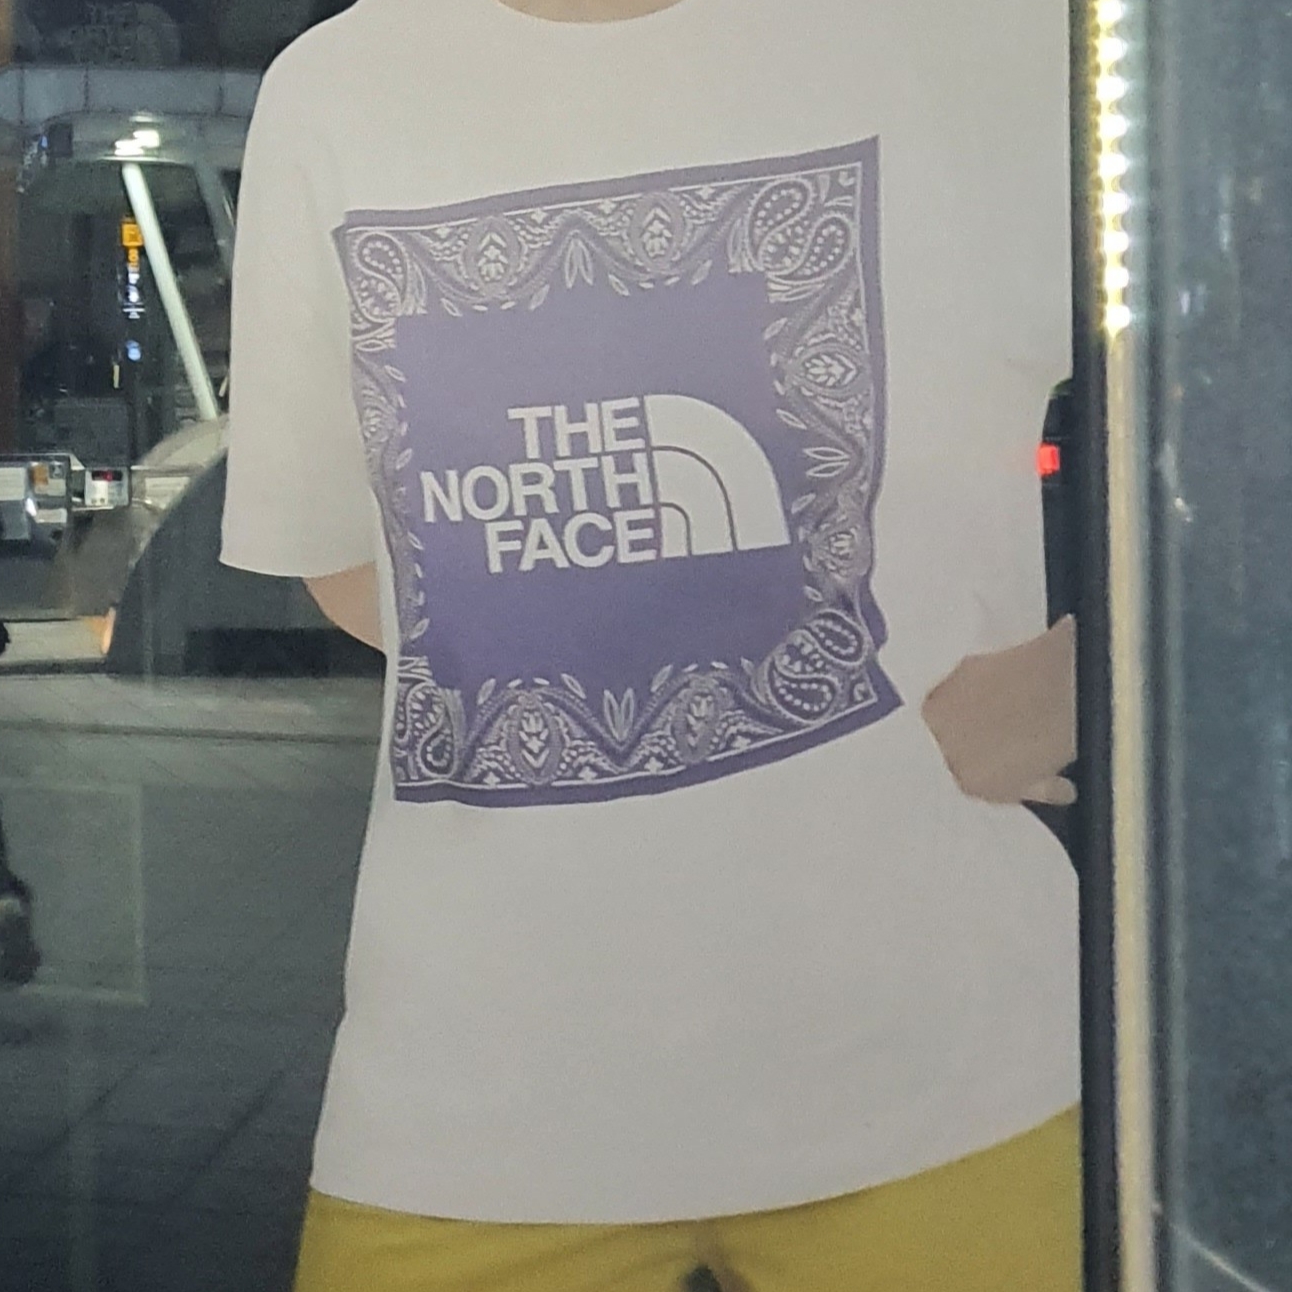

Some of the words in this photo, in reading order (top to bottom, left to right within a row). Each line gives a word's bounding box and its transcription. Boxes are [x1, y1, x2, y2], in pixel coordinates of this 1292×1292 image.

[507, 397, 645, 459] THE
[420, 452, 653, 523] NORTH
[485, 508, 657, 574] FACE
